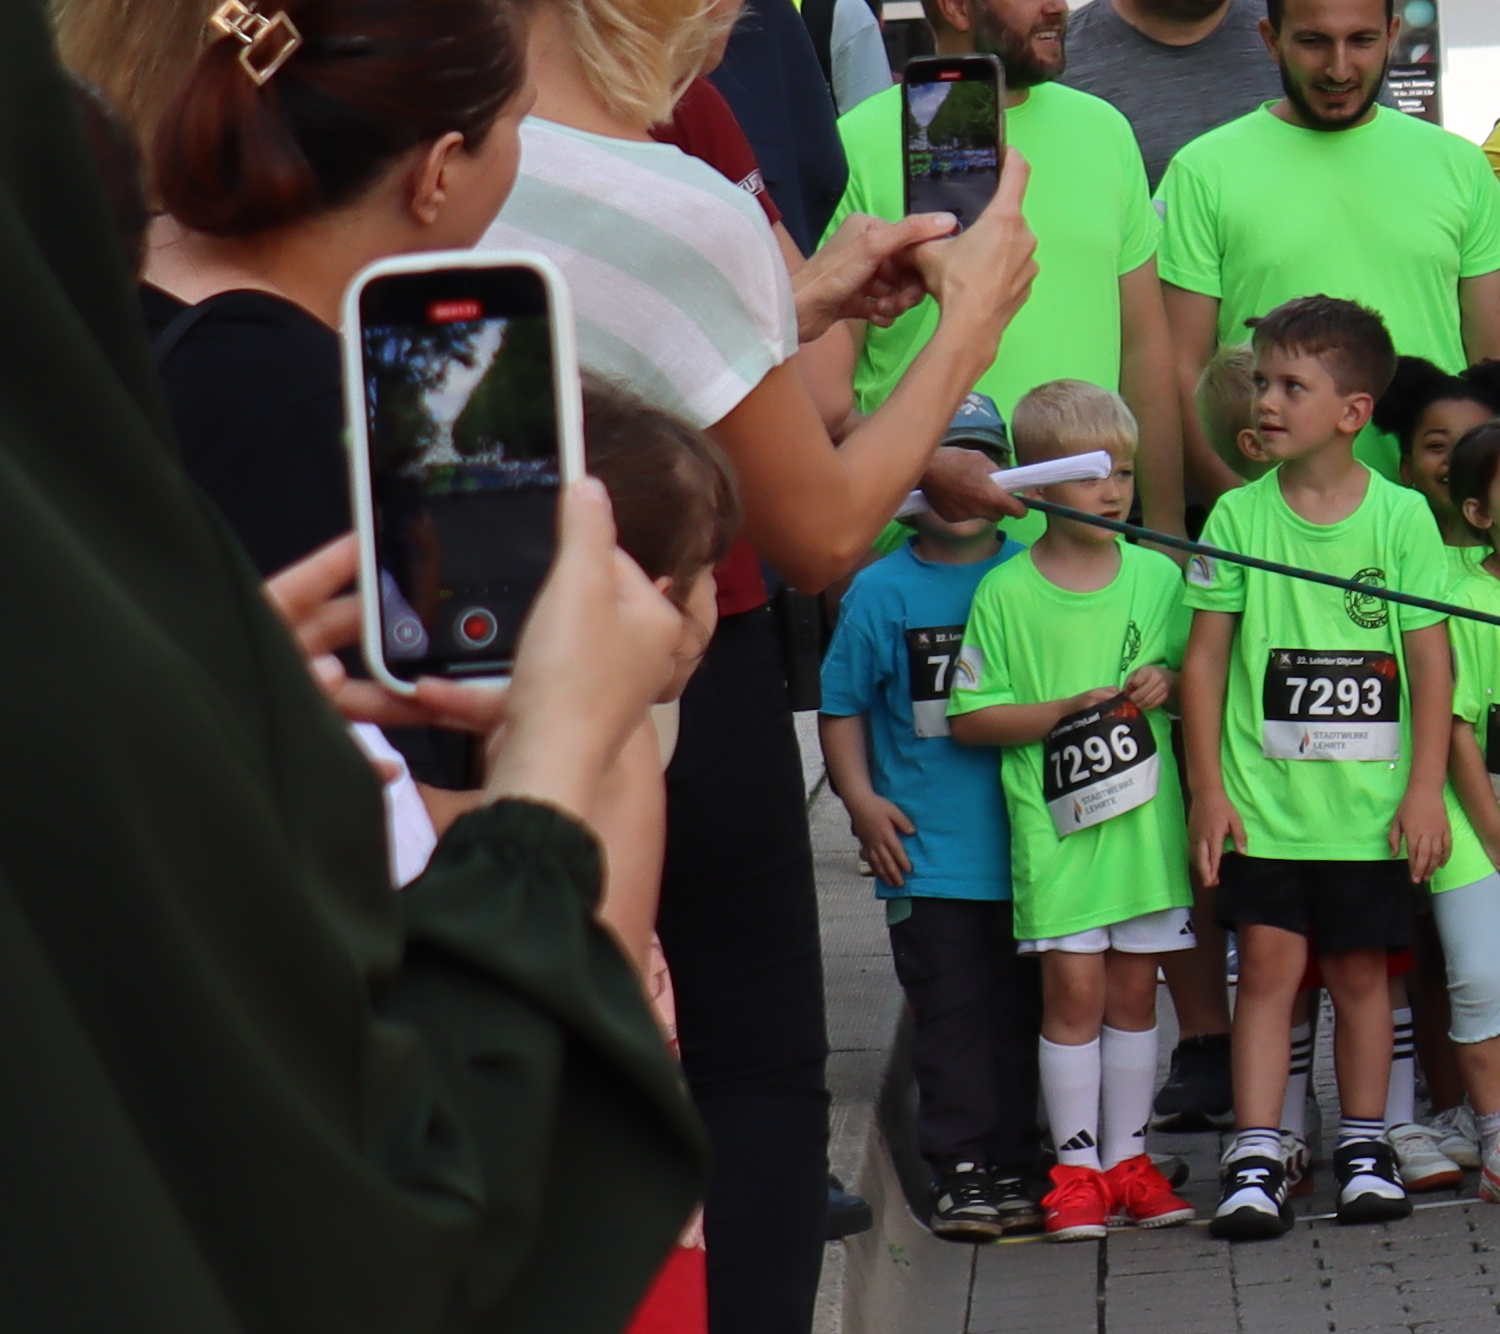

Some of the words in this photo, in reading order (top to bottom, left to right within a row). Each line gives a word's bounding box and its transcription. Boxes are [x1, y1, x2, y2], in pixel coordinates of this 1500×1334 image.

[1286, 677, 1382, 715] 7293
[1313, 732, 1369, 740] STADTWERKE
[1313, 741, 1347, 749] LEHRTE
[1051, 724, 1138, 789] 7296
[1081, 777, 1134, 807] STADTWERKE
[1085, 796, 1117, 817] LEHRTE
